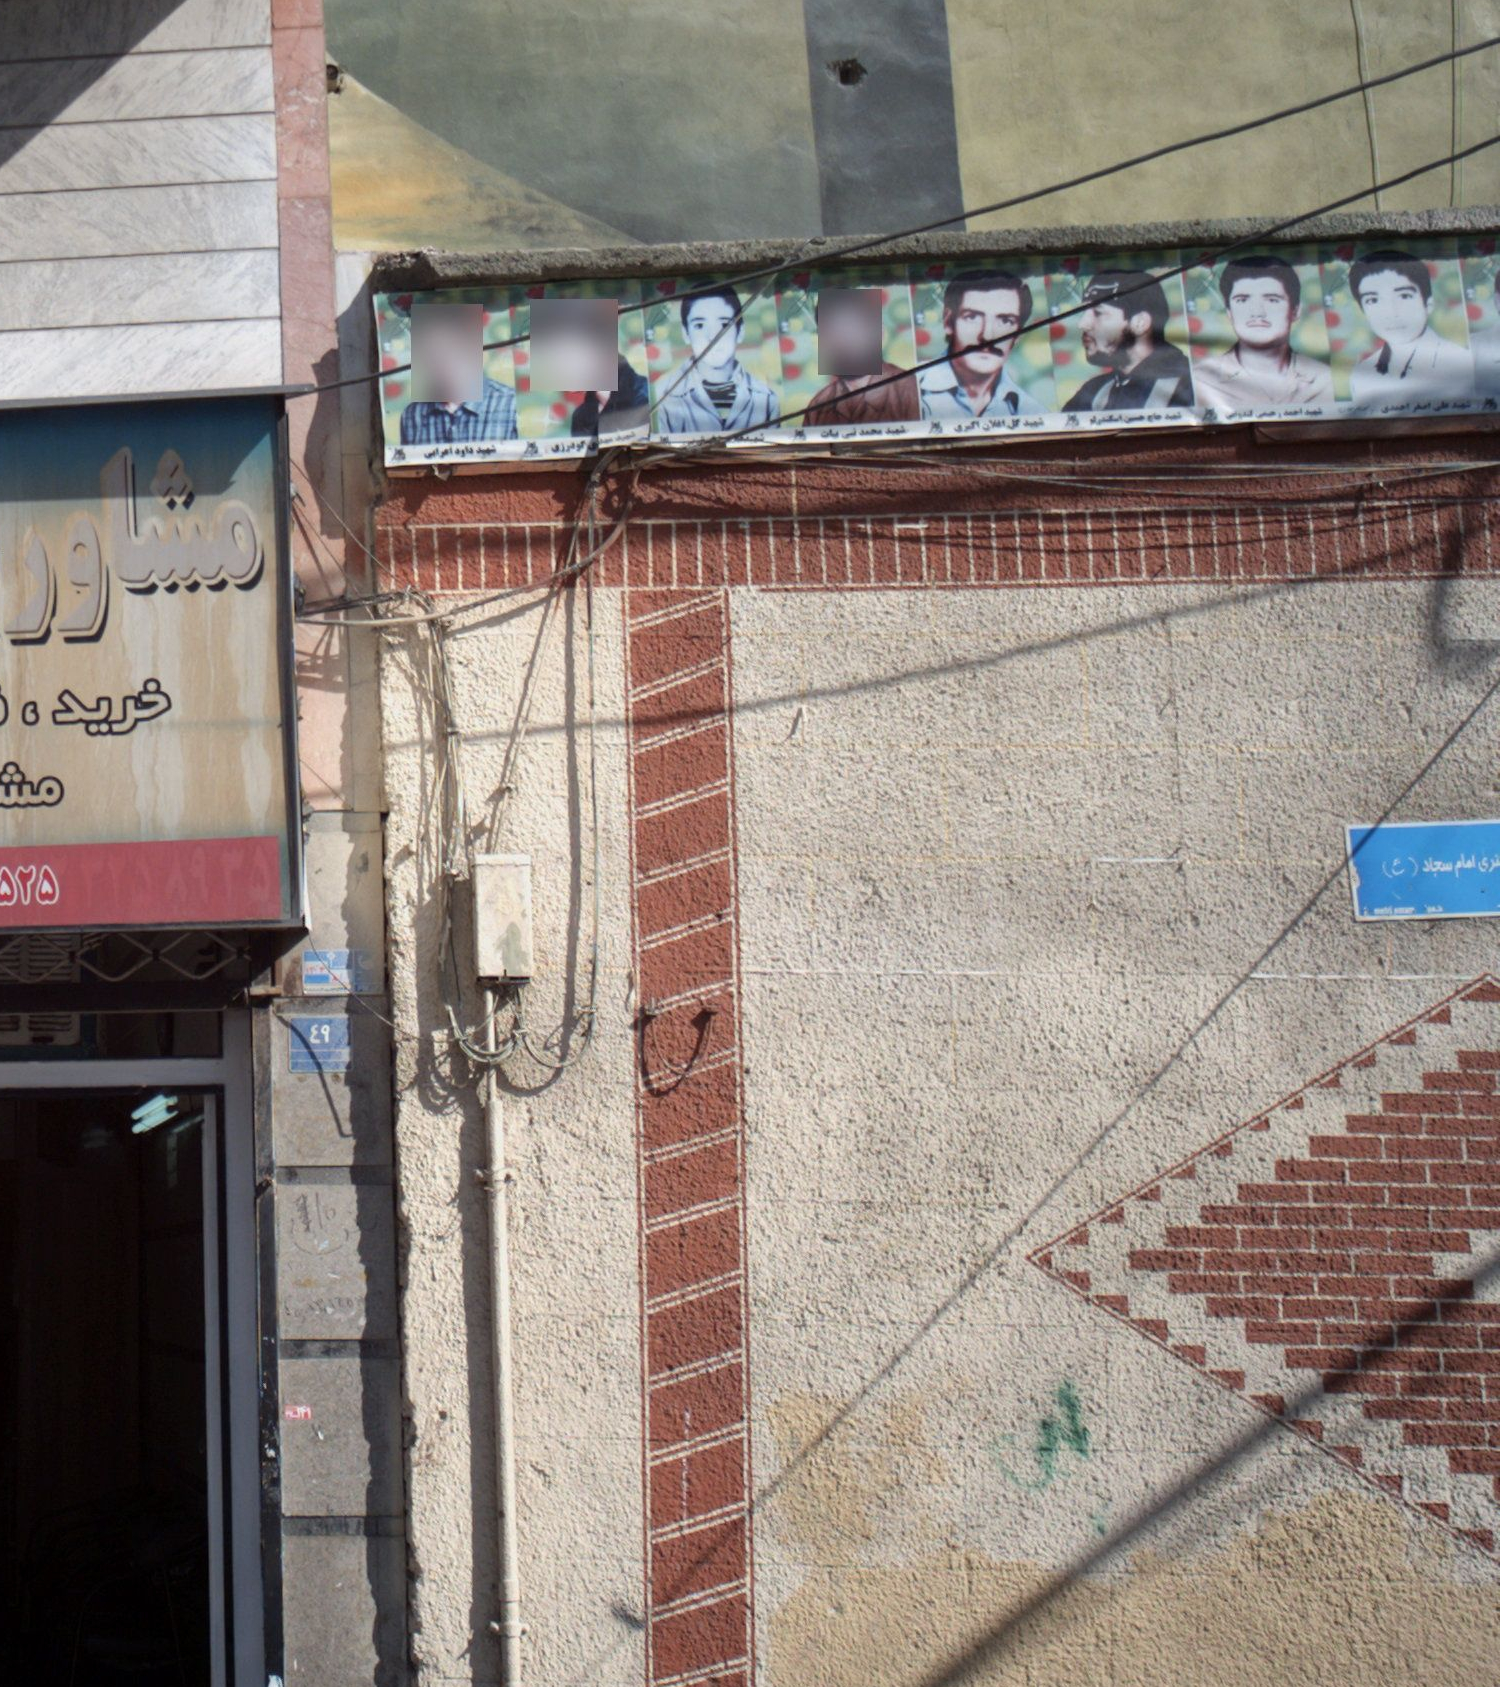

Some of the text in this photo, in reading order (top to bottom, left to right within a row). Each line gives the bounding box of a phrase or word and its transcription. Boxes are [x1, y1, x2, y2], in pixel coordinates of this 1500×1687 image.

[455, 445, 474, 458] داود
[477, 444, 497, 459] شهید
[1454, 853, 1476, 878] امام
